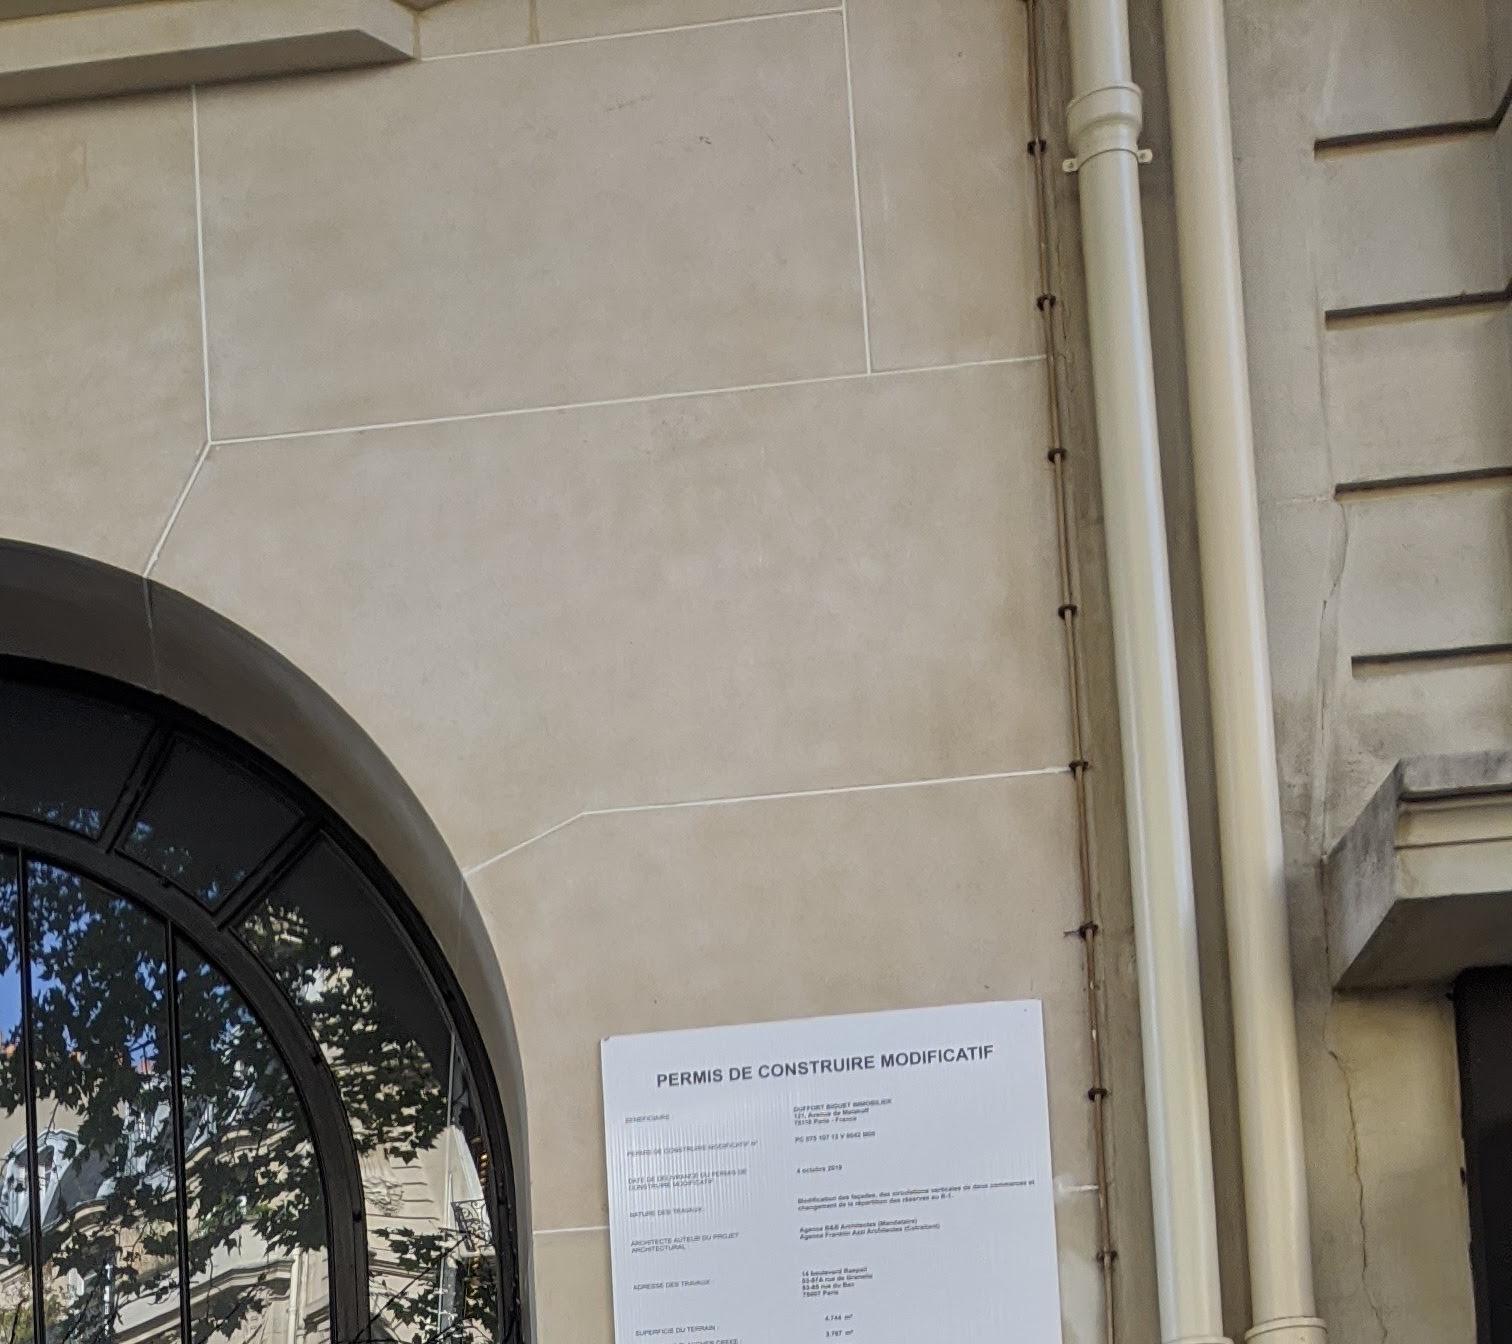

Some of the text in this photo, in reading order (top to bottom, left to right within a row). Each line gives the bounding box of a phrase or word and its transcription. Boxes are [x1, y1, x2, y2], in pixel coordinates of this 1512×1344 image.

[657, 1045, 994, 1087] PERMIS DE CONSTRUIRE MODIFICATIF
